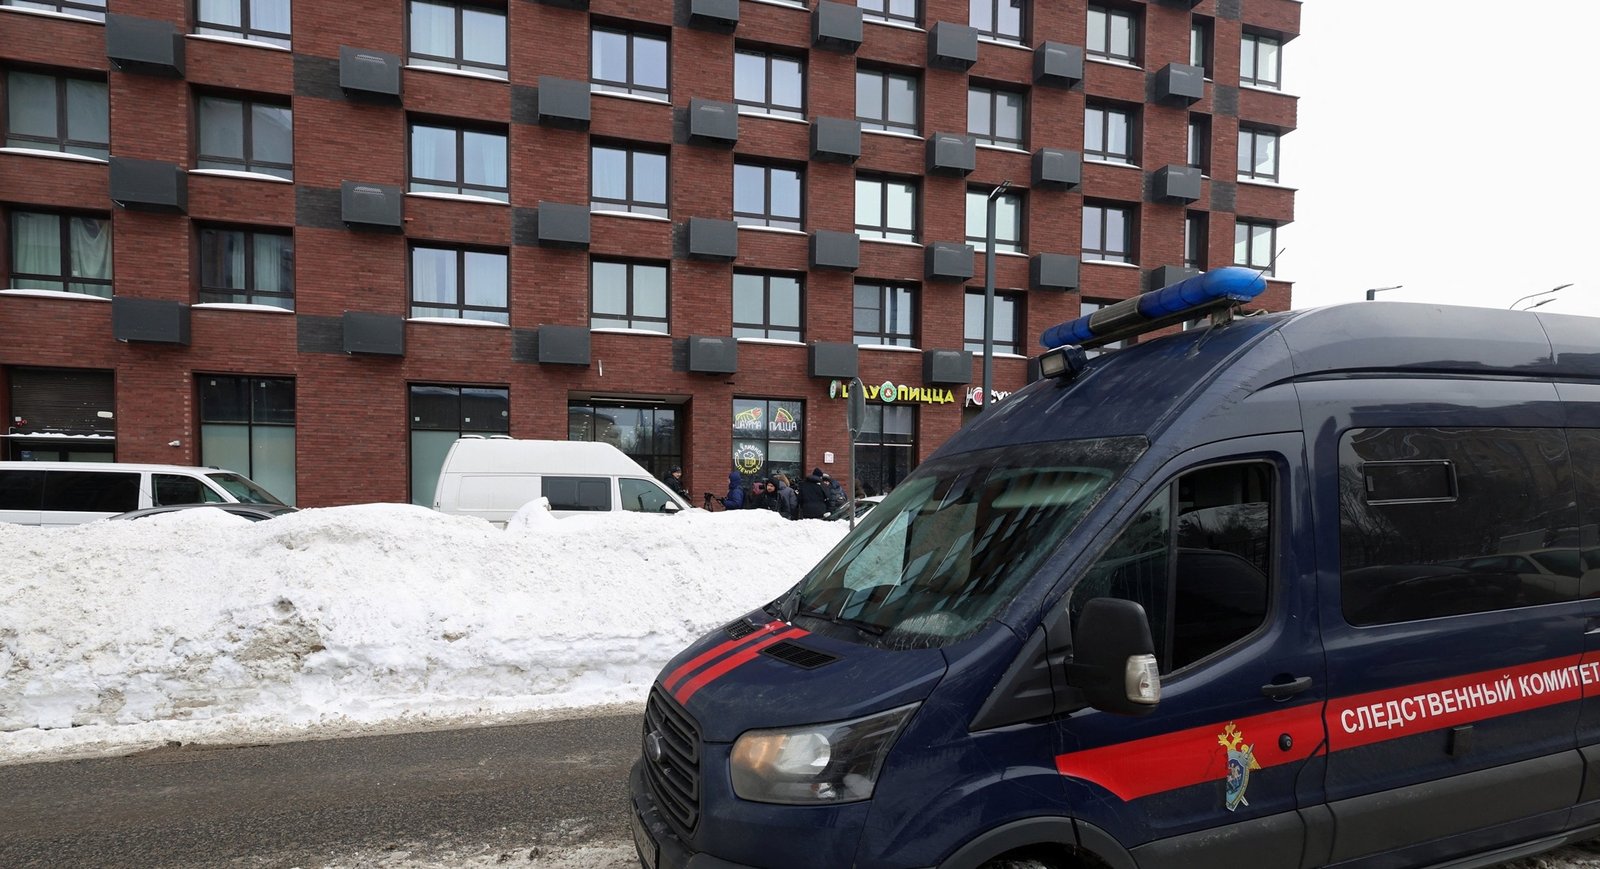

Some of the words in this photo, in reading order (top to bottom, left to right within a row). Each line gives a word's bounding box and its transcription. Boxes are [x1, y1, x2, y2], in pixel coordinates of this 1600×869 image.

[897, 384, 955, 405] ПИЦЦА
[769, 421, 798, 432] ПИЦЦА
[1340, 674, 1517, 734] СЛЕДСТВЕННЫЙ
[1517, 661, 1600, 698] КОМИТЕТ
